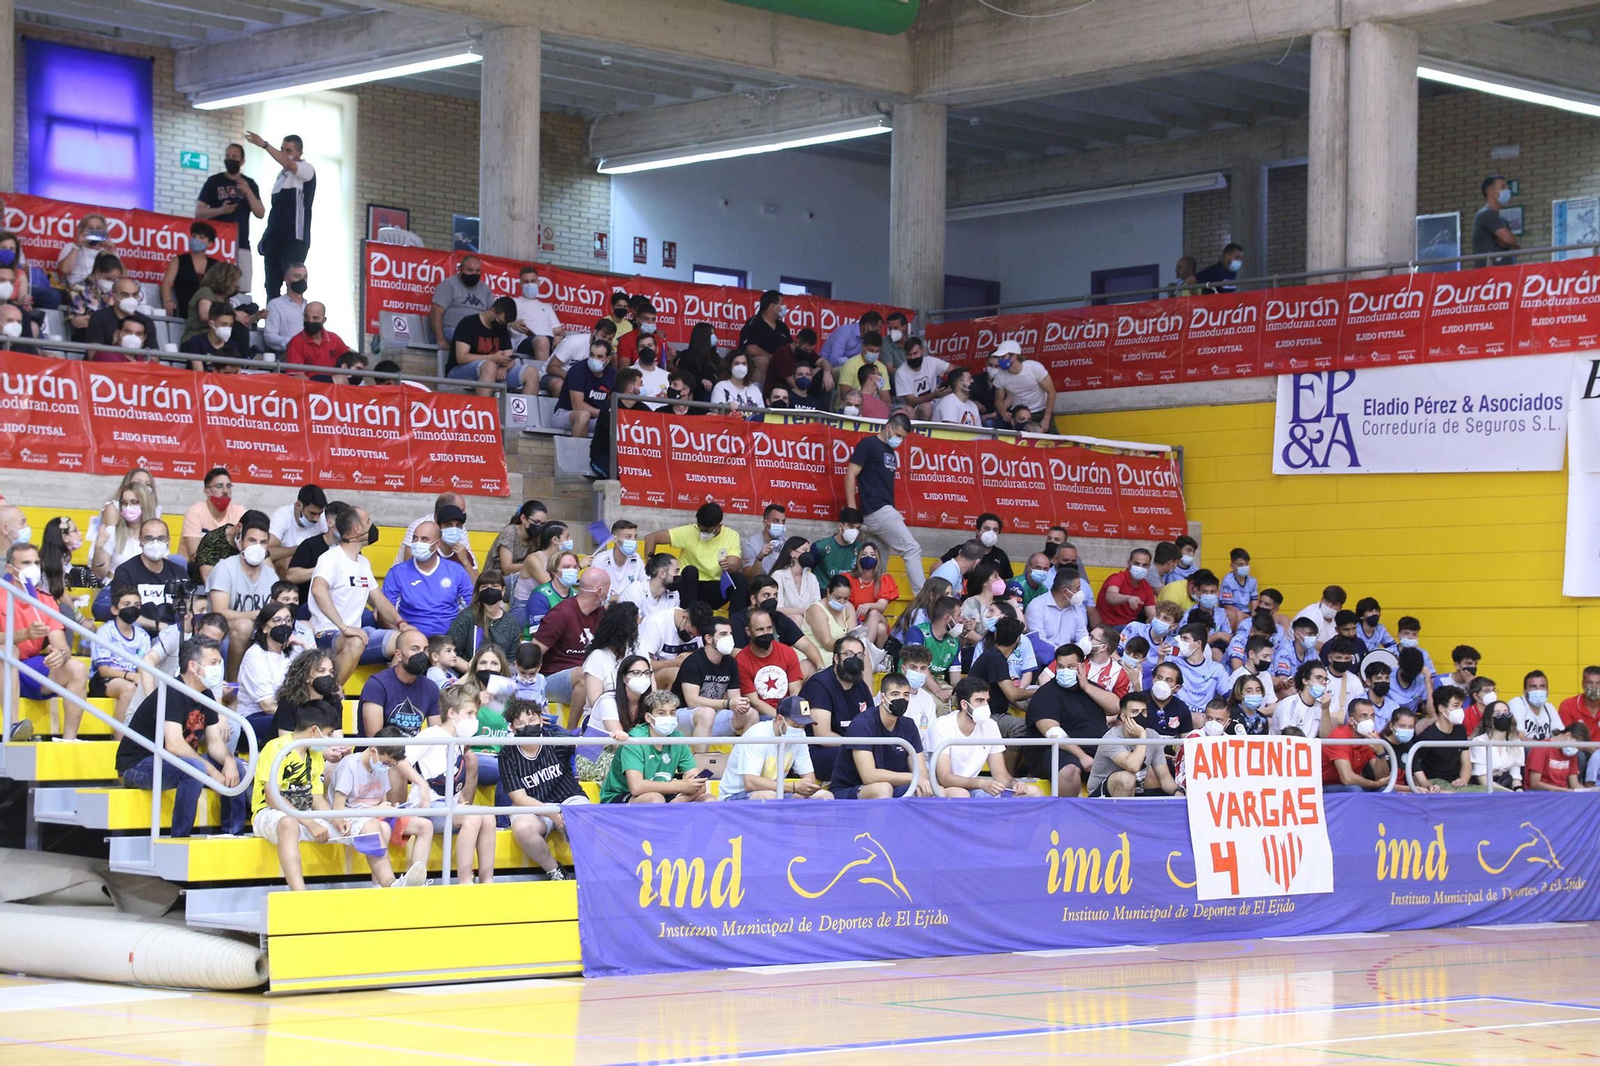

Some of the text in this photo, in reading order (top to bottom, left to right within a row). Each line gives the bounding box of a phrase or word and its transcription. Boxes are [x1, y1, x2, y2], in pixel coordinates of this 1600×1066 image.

[371, 252, 445, 283] Durán
[370, 276, 435, 294] inmoduran.co
[1433, 278, 1512, 306] Durán
[383, 300, 405, 309] EJIDO
[684, 295, 747, 321] Durán
[1266, 297, 1339, 320] Durán
[1348, 287, 1424, 314] Durán
[1431, 300, 1509, 317] inmoduran.com
[1190, 303, 1256, 328] Durán
[1347, 309, 1420, 324] inmoduran.com
[1532, 315, 1588, 326] EJIDO FUTSAL
[1045, 320, 1109, 342] Durán
[1118, 312, 1182, 337] Durán
[1188, 325, 1255, 339] inmoduran.com
[1265, 318, 1336, 331] inmoduran.com
[1442, 323, 1494, 334] EJIDO FUTSAL
[1114, 333, 1179, 346] inmoduran.com
[1275, 337, 1322, 348] EJIDO FUTSAL
[1356, 330, 1406, 341] EJIDO FUTSAL
[1043, 340, 1105, 352] inmoduran.com
[1198, 345, 1243, 355] EJIDO FUTSAL
[1052, 358, 1093, 368] EJIDO FUTSAL
[1123, 352, 1166, 362] EJIDO FUTSAL
[3, 370, 78, 400] urán
[90, 374, 191, 410] Durán
[203, 384, 298, 419] Durán
[309, 394, 400, 426] Durán
[1363, 393, 1563, 415] Eladio Pérez & Asociados
[94, 404, 193, 423] inmoduran.com
[206, 412, 299, 432] inmoduran.com
[410, 402, 495, 430] Durán
[27, 425, 66, 436] FUTSAL
[312, 422, 401, 440] inmoduran.com
[1362, 416, 1561, 436] Correduría de Seguros S.L.
[113, 431, 180, 445] EJIDO FUTSAL
[413, 429, 496, 444] inmoduran.com
[669, 424, 745, 454] Durán
[226, 440, 288, 453] EJIDO FUTSAL
[330, 448, 389, 460] EJIDO FUTSAL
[752, 432, 824, 462] Durán
[430, 453, 486, 464] EJIDO FUTSAL
[672, 449, 746, 466] inmoduran.com
[756, 456, 825, 473] inmoduran.com
[910, 446, 973, 474] Durán
[981, 453, 1044, 479] Durán
[623, 466, 652, 477] FUTSAL
[686, 474, 736, 485] EJIDO FUTSAL
[910, 471, 975, 484] inmoduran.com
[1049, 458, 1111, 484] Durán
[770, 480, 817, 490] EJIDO FUTSAL
[983, 476, 1046, 490] inmoduran.com
[1053, 481, 1112, 495] inmoduran.com
[924, 492, 968, 502] EJIDO FUTSAL
[1015, 499, 1039, 507] FUTSAL
[1066, 502, 1106, 512] EJIDO FUTSAL
[1133, 506, 1172, 515] EJIDO FUTSAL
[1207, 788, 1318, 829] VARGAS
[1374, 822, 1450, 881] imd
[1046, 830, 1133, 895] imd
[1210, 841, 1240, 895] 4
[636, 835, 745, 908] imd
[1390, 892, 1430, 905] Instituto
[1433, 888, 1483, 906] Municipal
[1486, 888, 1498, 900] de
[1062, 899, 1295, 922] Instituto Municipal de Deportes de El Ejido
[722, 918, 794, 937] Municipal
[798, 917, 812, 933] de
[818, 914, 873, 932] Deportes
[877, 912, 891, 927] de
[895, 910, 910, 926] El
[914, 910, 949, 927] Ejido
